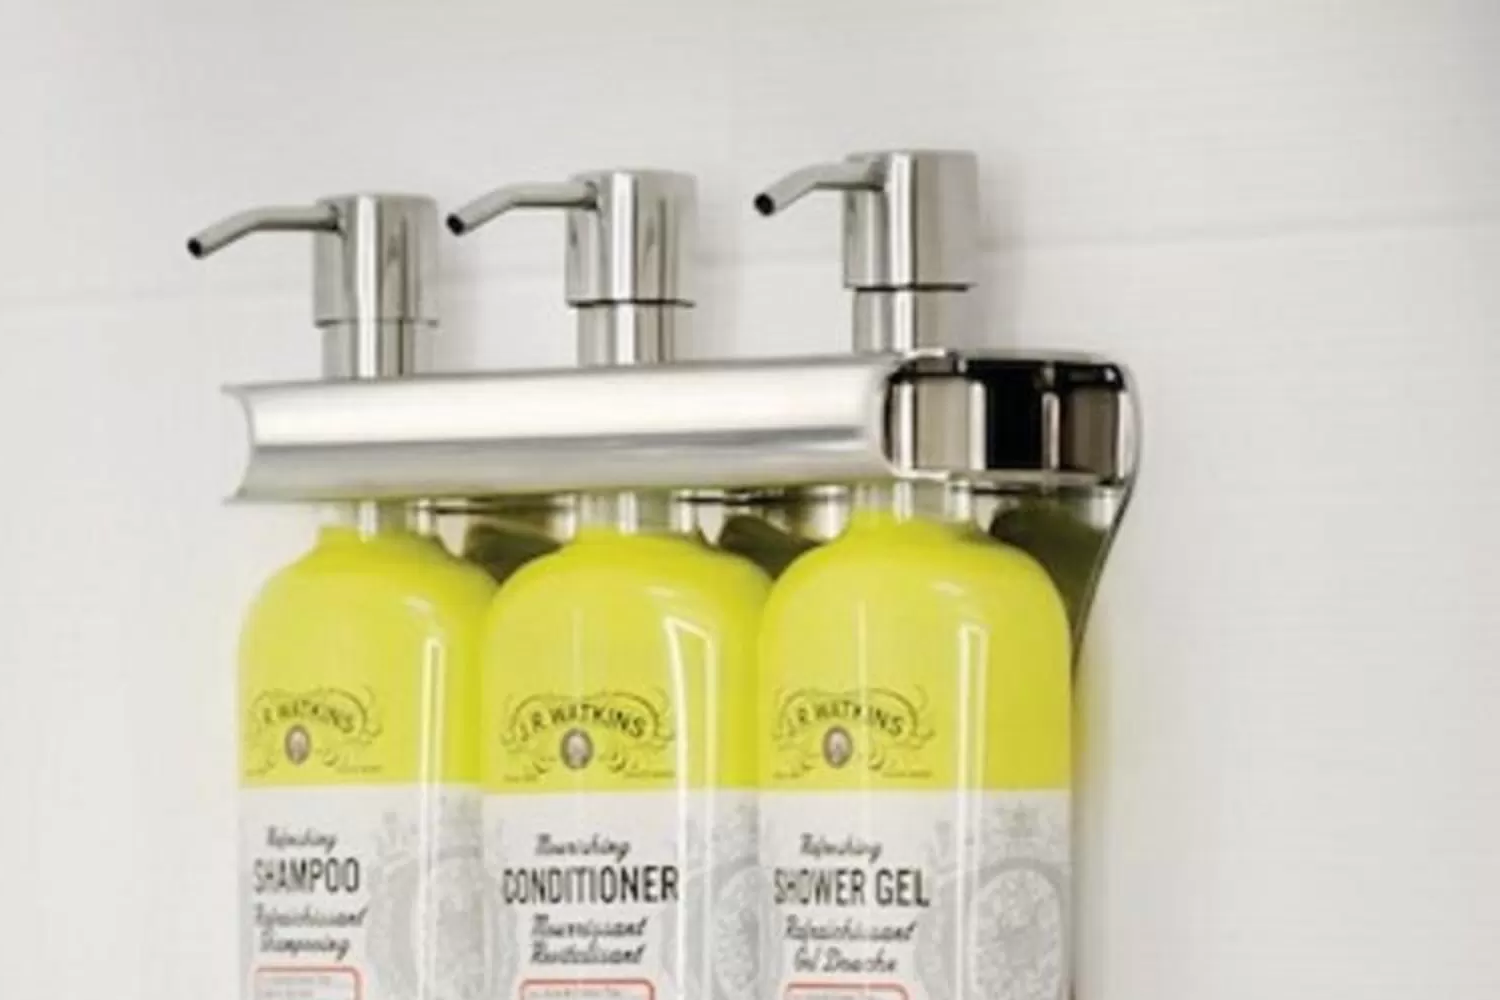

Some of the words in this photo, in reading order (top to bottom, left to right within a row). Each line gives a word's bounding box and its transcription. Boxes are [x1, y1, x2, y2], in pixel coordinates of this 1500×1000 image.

[548, 702, 648, 739] WATKINS
[813, 699, 905, 738] WATKINS
[535, 832, 631, 863] Nourishing
[254, 856, 360, 893] SHAMPOO
[501, 865, 680, 905] CONDITIONER
[774, 867, 867, 906] SHOWER
[874, 867, 931, 907] GEL
